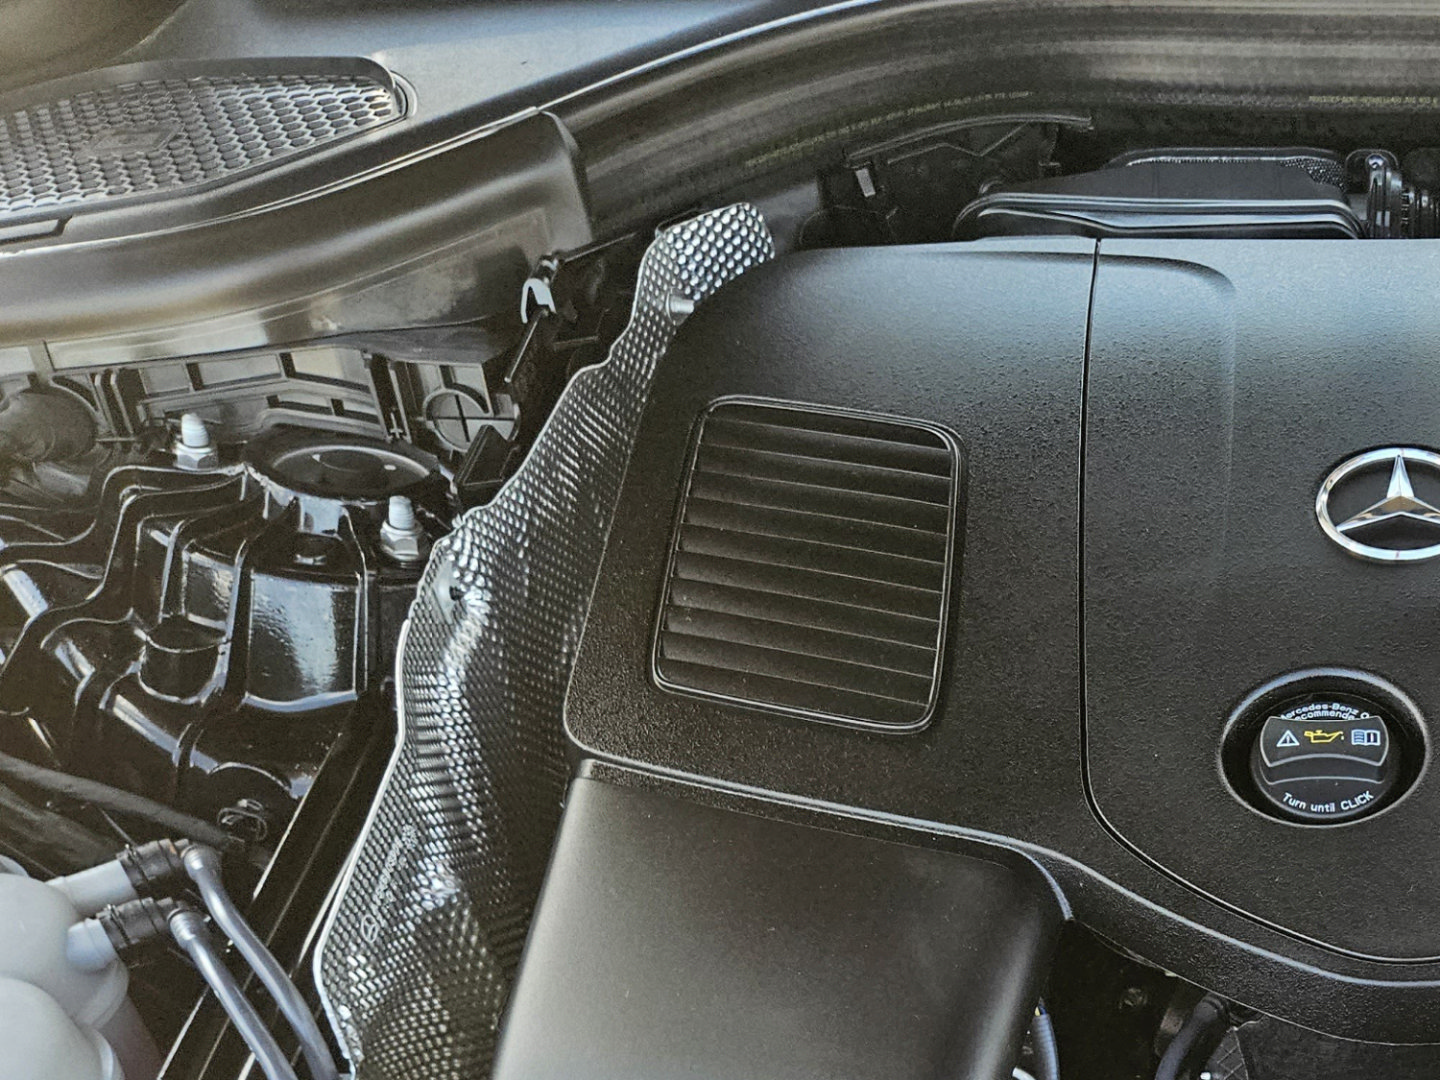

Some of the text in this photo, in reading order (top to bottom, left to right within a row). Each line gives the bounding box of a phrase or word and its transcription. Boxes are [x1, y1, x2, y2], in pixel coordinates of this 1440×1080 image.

[1282, 791, 1375, 813] Turn until CLICK
